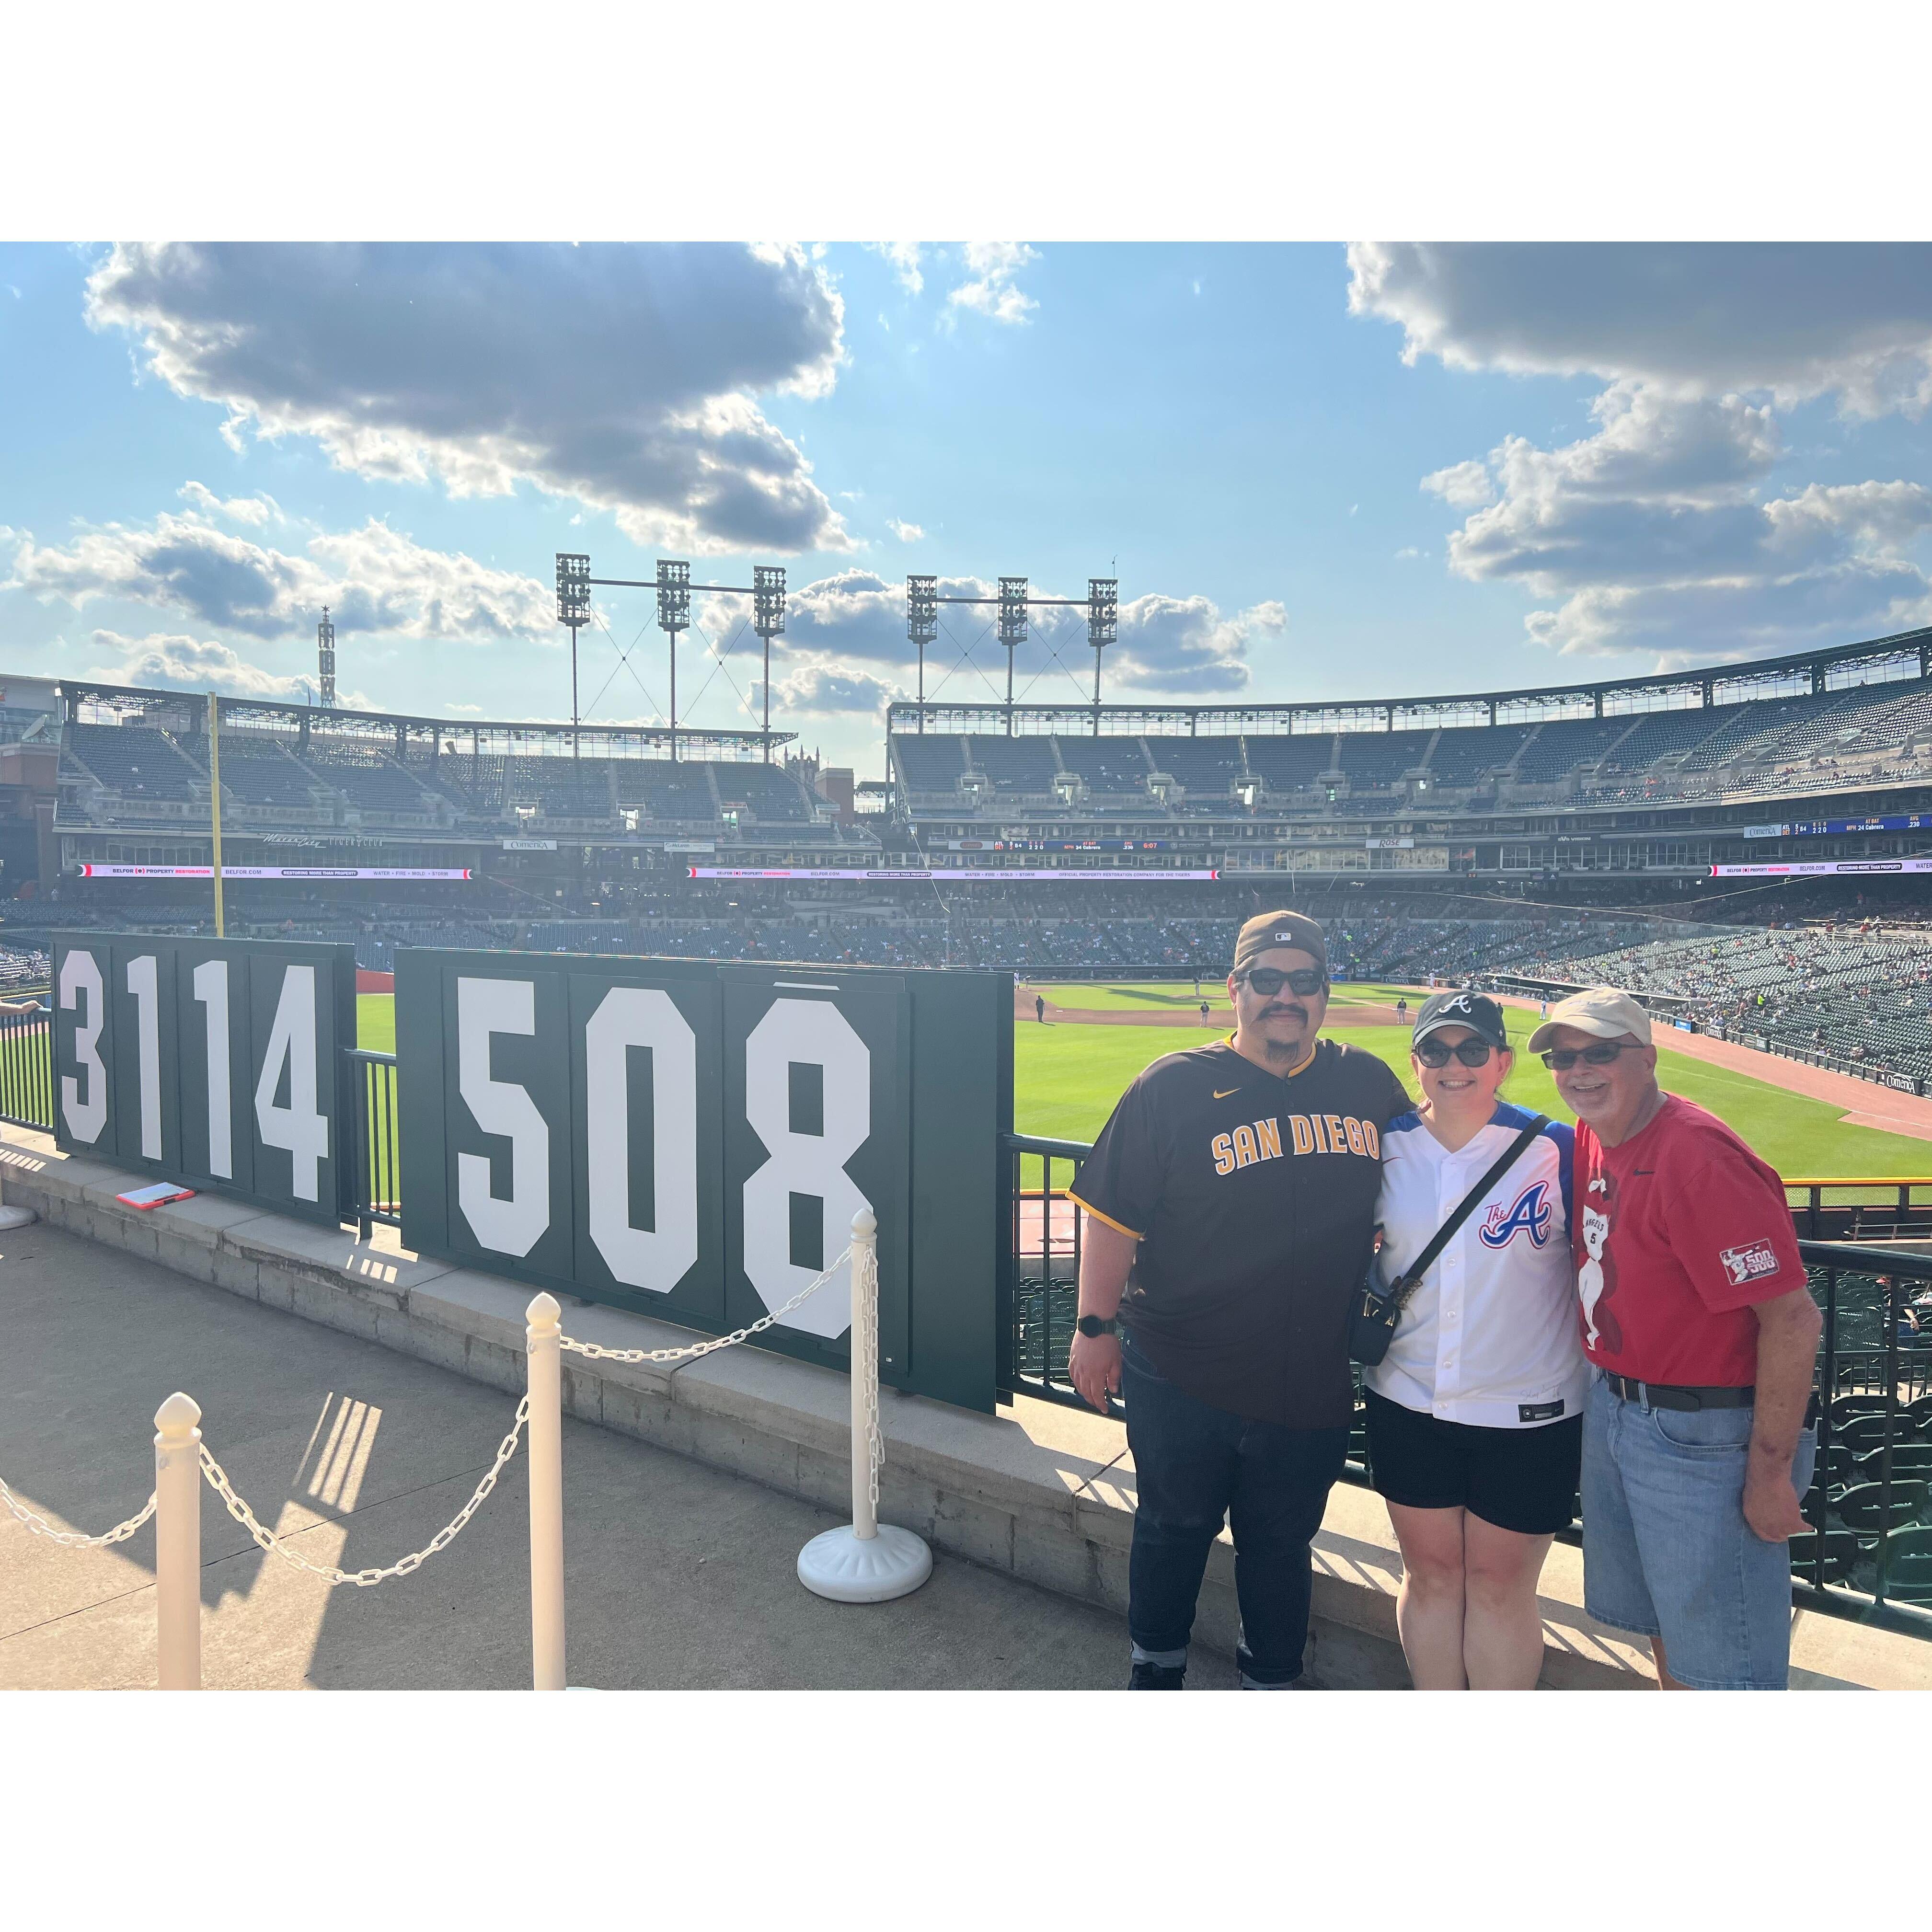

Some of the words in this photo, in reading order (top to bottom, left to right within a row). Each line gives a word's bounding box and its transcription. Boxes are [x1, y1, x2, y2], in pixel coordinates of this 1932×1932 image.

[1379, 839, 1400, 848] ROSE
[1438, 994, 1472, 1013] A
[60, 950, 329, 1202] 3114
[457, 977, 874, 1339] 508
[1211, 1117, 1284, 1176] SAN
[1288, 1114, 1380, 1161] DIEGO
[1479, 1180, 1552, 1250] A
[1484, 1201, 1506, 1224] The
[1590, 1232, 1597, 1244] 5
